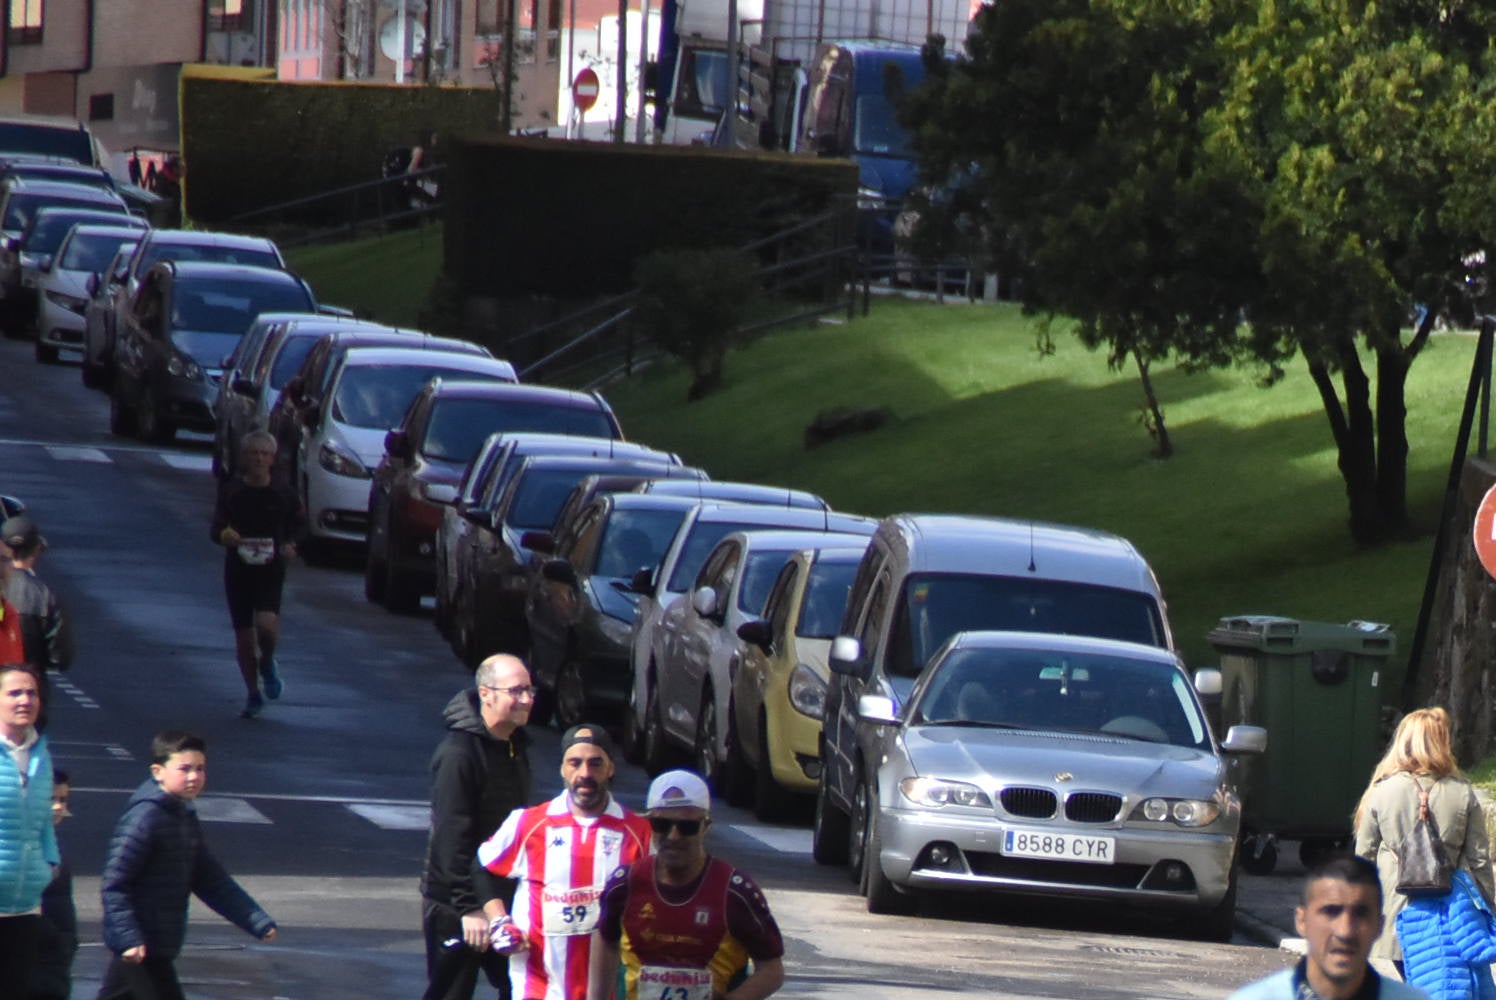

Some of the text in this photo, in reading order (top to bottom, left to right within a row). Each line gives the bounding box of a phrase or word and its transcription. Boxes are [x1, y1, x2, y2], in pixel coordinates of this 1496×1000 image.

[1017, 834, 1065, 854] 8588
[1072, 839, 1109, 858] CYR
[562, 905, 587, 923] 59
